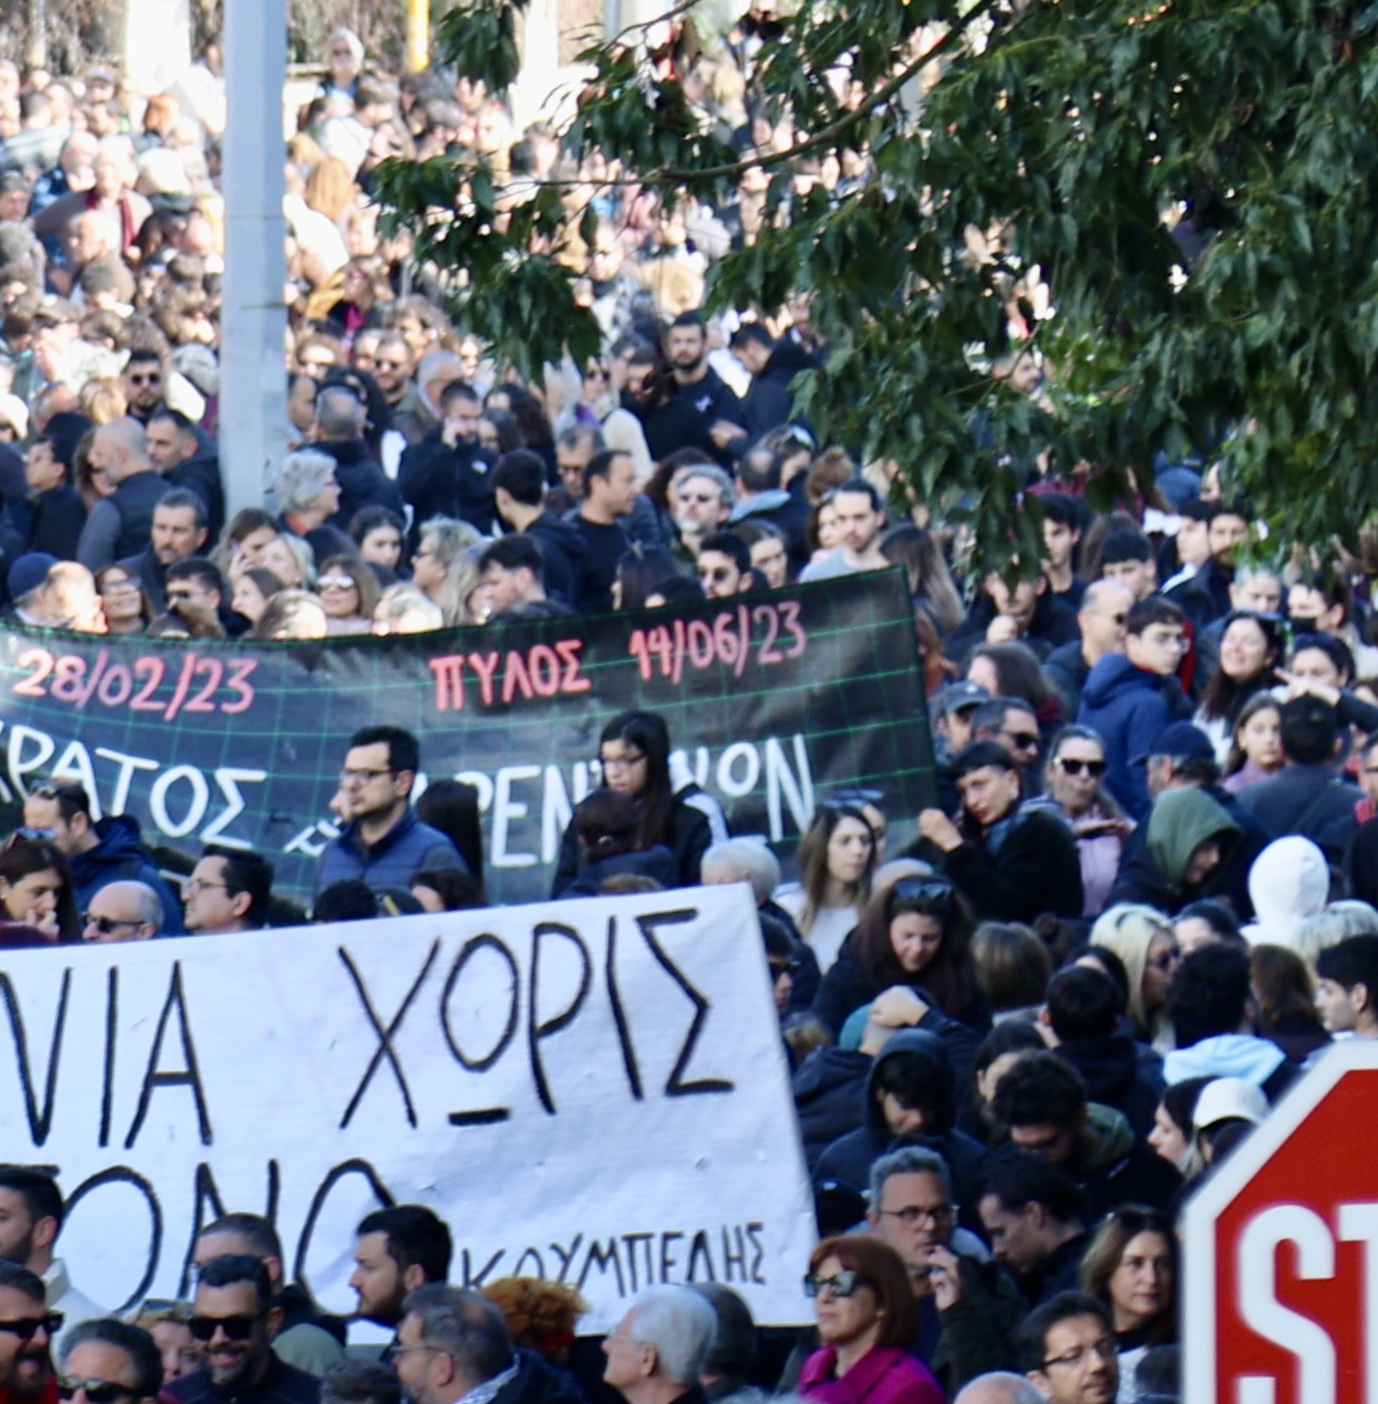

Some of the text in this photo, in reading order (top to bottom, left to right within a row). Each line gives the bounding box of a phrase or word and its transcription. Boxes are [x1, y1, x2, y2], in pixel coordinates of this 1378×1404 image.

[12, 648, 258, 721] 28/02/23
[429, 601, 808, 711] ΠΥΛΟΣ 14/06/23
[337, 907, 736, 1130] ΧΩΡΙΣ
